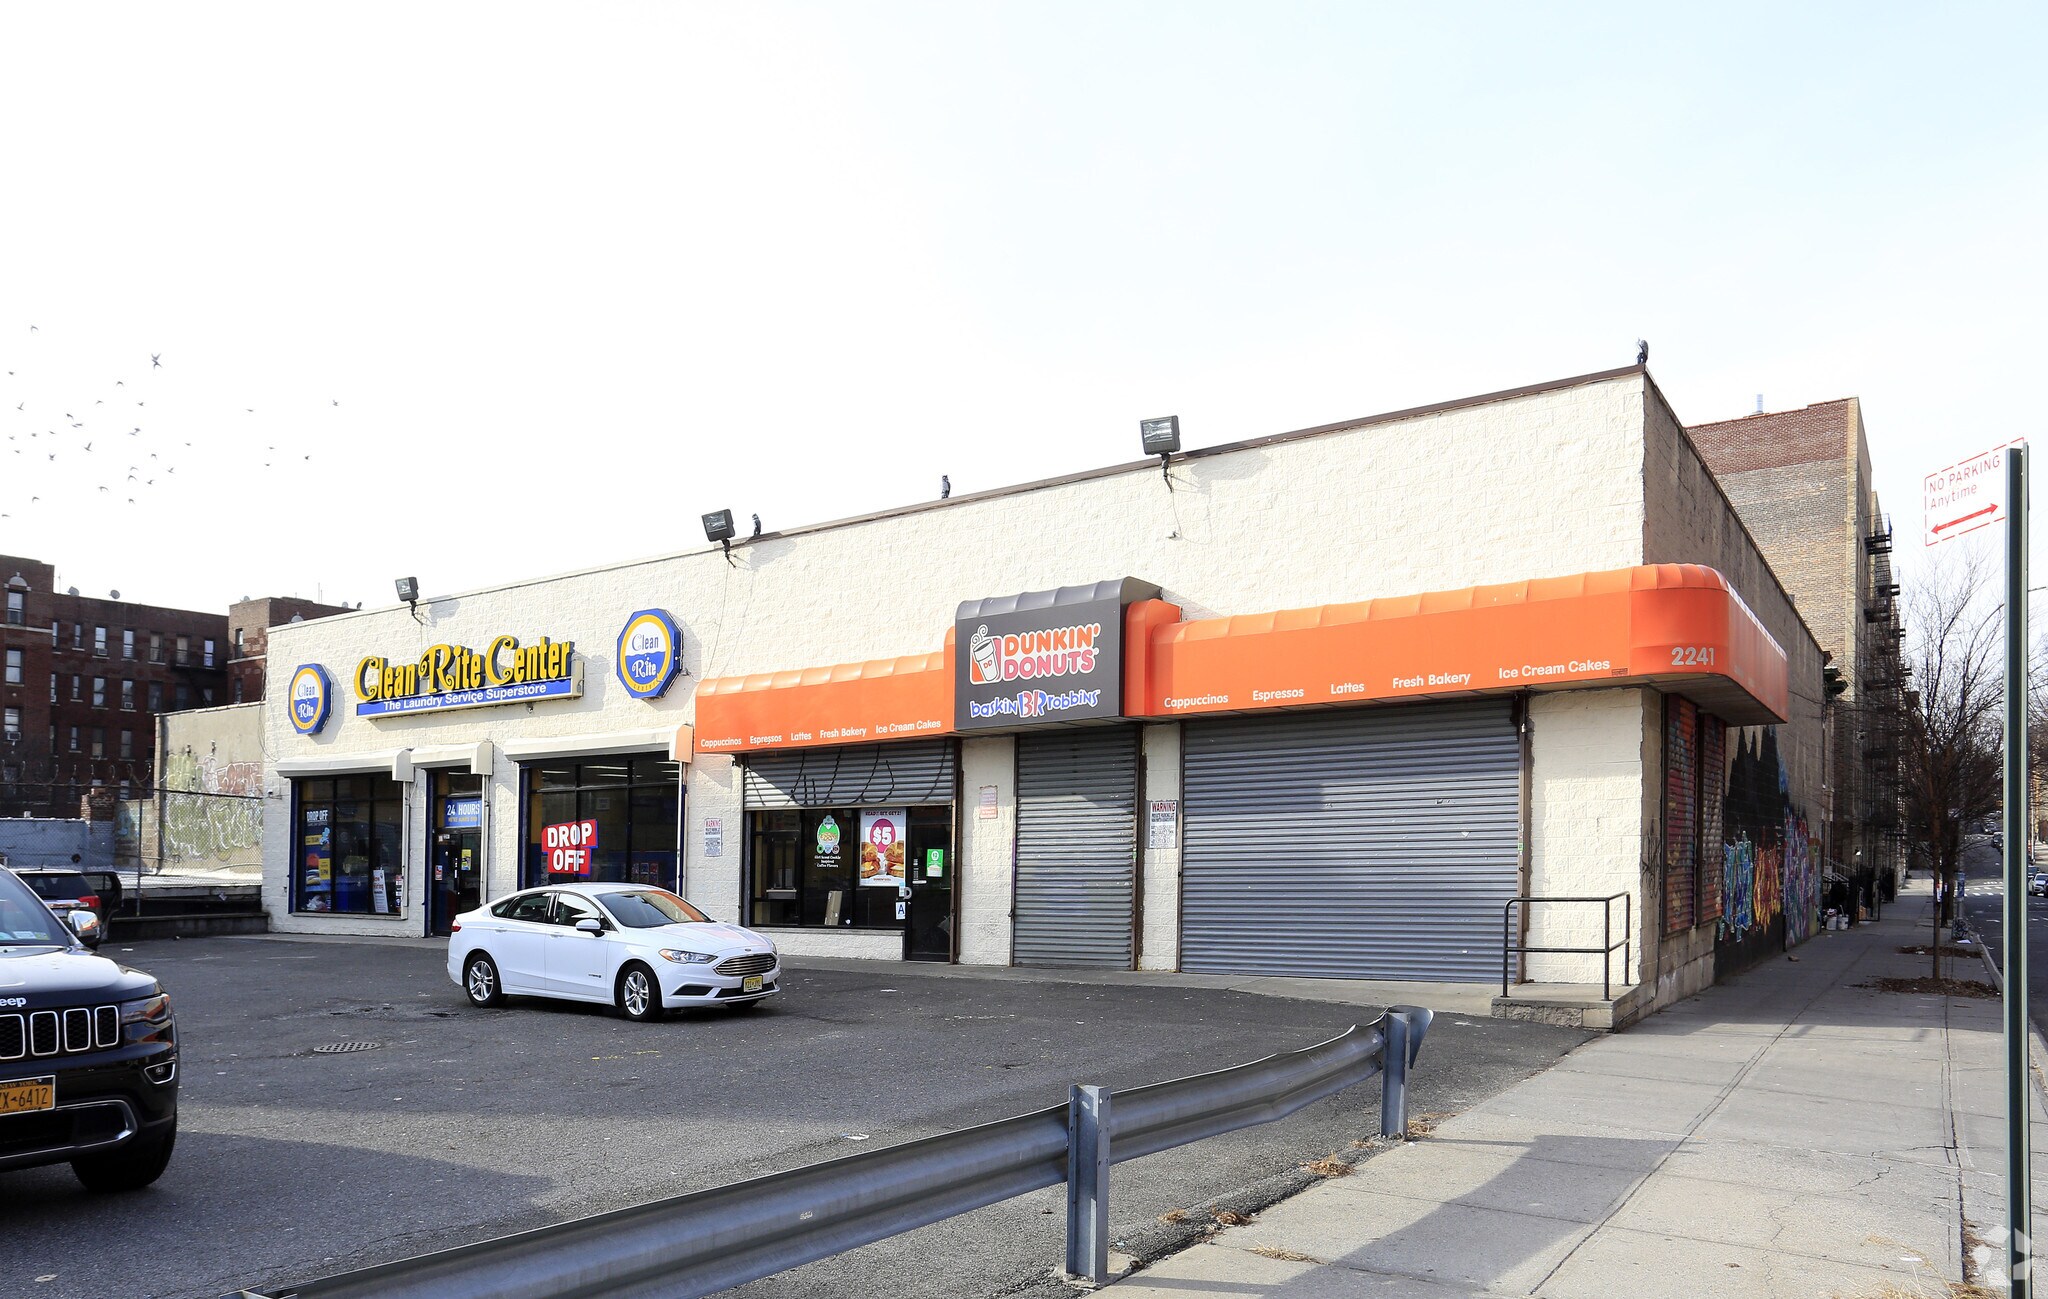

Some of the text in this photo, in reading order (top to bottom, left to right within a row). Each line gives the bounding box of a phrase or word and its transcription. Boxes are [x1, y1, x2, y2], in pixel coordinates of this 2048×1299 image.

[1929, 455, 2000, 494] NO PARKING
[1930, 484, 1978, 510] Anytime
[632, 633, 659, 651] Clean
[1004, 625, 1099, 657] DUNKIN'
[1004, 649, 1094, 680] DONUTS
[1671, 646, 1714, 666] 2241
[354, 634, 573, 701] Clean Rite Center
[631, 657, 657, 678] Rite
[297, 683, 315, 697] Clean
[1164, 693, 1229, 709] Cappuccinos
[1252, 688, 1305, 702] Espressos
[1330, 682, 1365, 695] Lattes
[1392, 674, 1424, 689] Fresh
[1428, 671, 1471, 686] Bakery
[1498, 667, 1519, 680] Ice
[1521, 664, 1565, 678] Cream
[1568, 659, 1611, 673] Cakes
[383, 684, 547, 712] The Laundry Service Superstore
[971, 698, 1017, 717] baskin
[1048, 690, 1098, 710] robbins
[297, 701, 314, 718] Rite
[700, 719, 942, 748] Cappuccinos Espressos Lattes Fresh Bakery Ice Cream Cakes
[306, 809, 328, 821] DROP OFF
[447, 803, 480, 816] 24 HOURS
[1151, 802, 1176, 812] WARNING
[547, 822, 593, 848] DROP
[872, 826, 892, 846] $5
[553, 848, 586, 872] OFF
[897, 904, 905, 914] A
[0, 997, 27, 1007] eep
[18, 1087, 48, 1107] 6412
